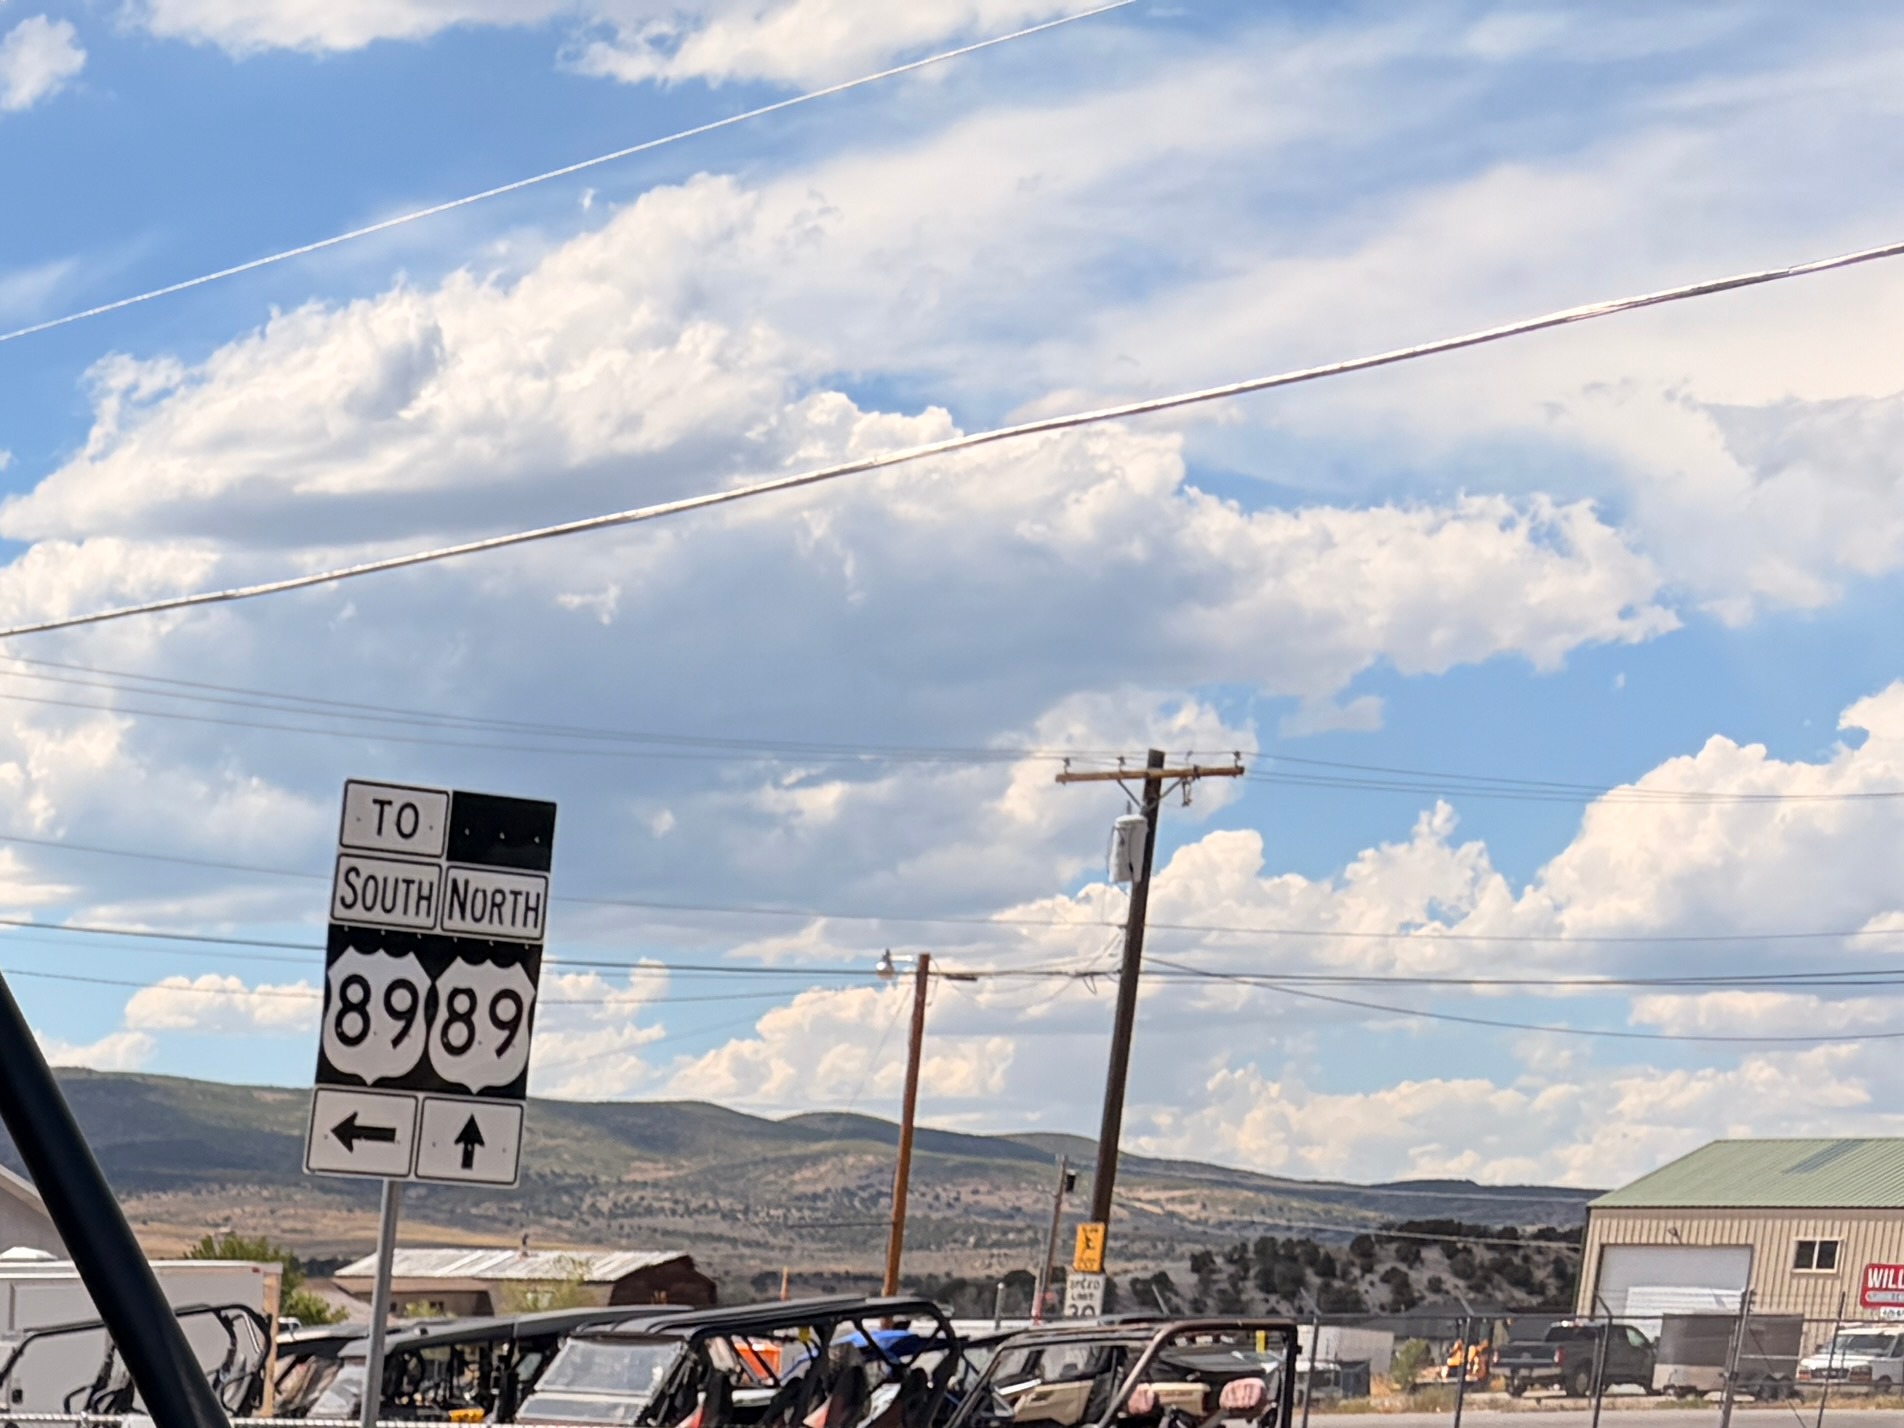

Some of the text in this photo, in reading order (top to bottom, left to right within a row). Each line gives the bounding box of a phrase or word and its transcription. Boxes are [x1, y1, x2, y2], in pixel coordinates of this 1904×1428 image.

[372, 798, 419, 839] TO
[340, 866, 434, 919] SOUTH
[447, 877, 540, 930] NORTH
[334, 973, 419, 1049] 89
[440, 986, 523, 1060] 89
